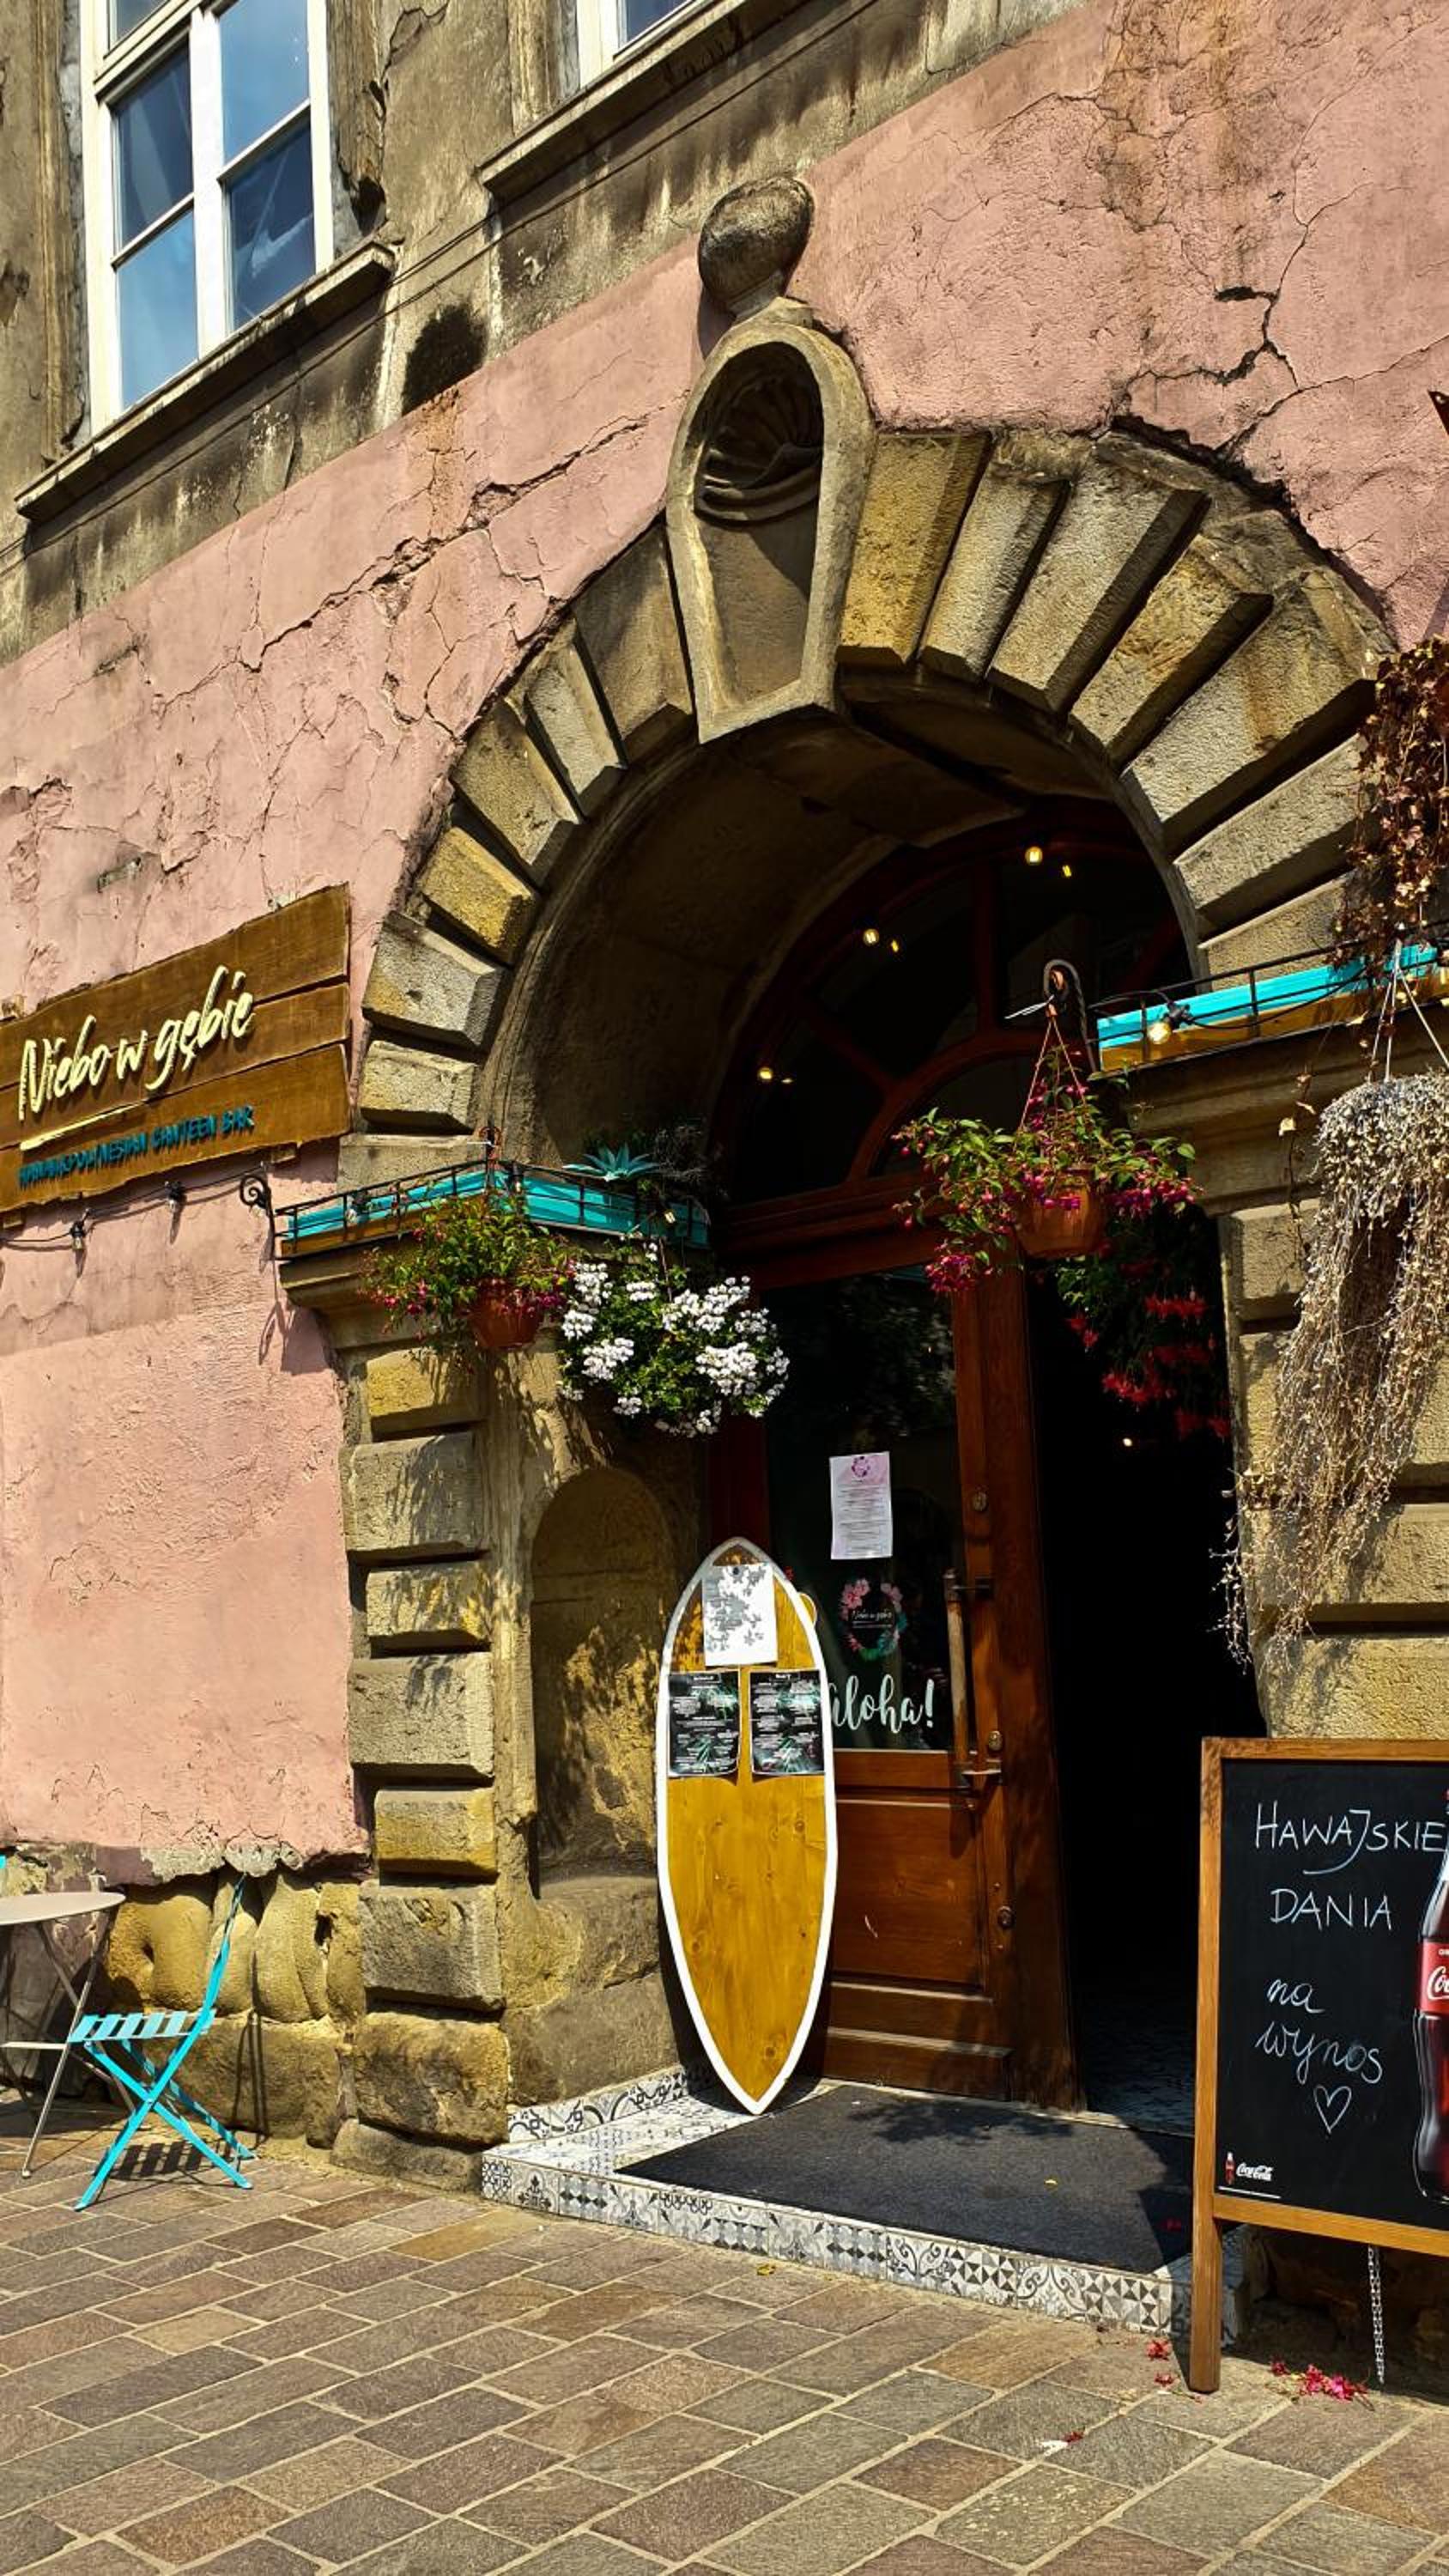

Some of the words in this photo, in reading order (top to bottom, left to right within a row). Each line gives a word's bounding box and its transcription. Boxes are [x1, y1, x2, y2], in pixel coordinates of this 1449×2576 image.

[19, 1015, 112, 1121] Niebo
[117, 1030, 149, 1079] w
[145, 964, 256, 1091] gębie
[151, 1115, 217, 1148] CANTEEN
[221, 1105, 254, 1133] BAR
[1255, 1800, 1446, 1874] HAWAJSKIE
[1270, 1888, 1391, 1930] DANIA
[1266, 1978, 1325, 2014] na
[1254, 2020, 1384, 2084] wynos
